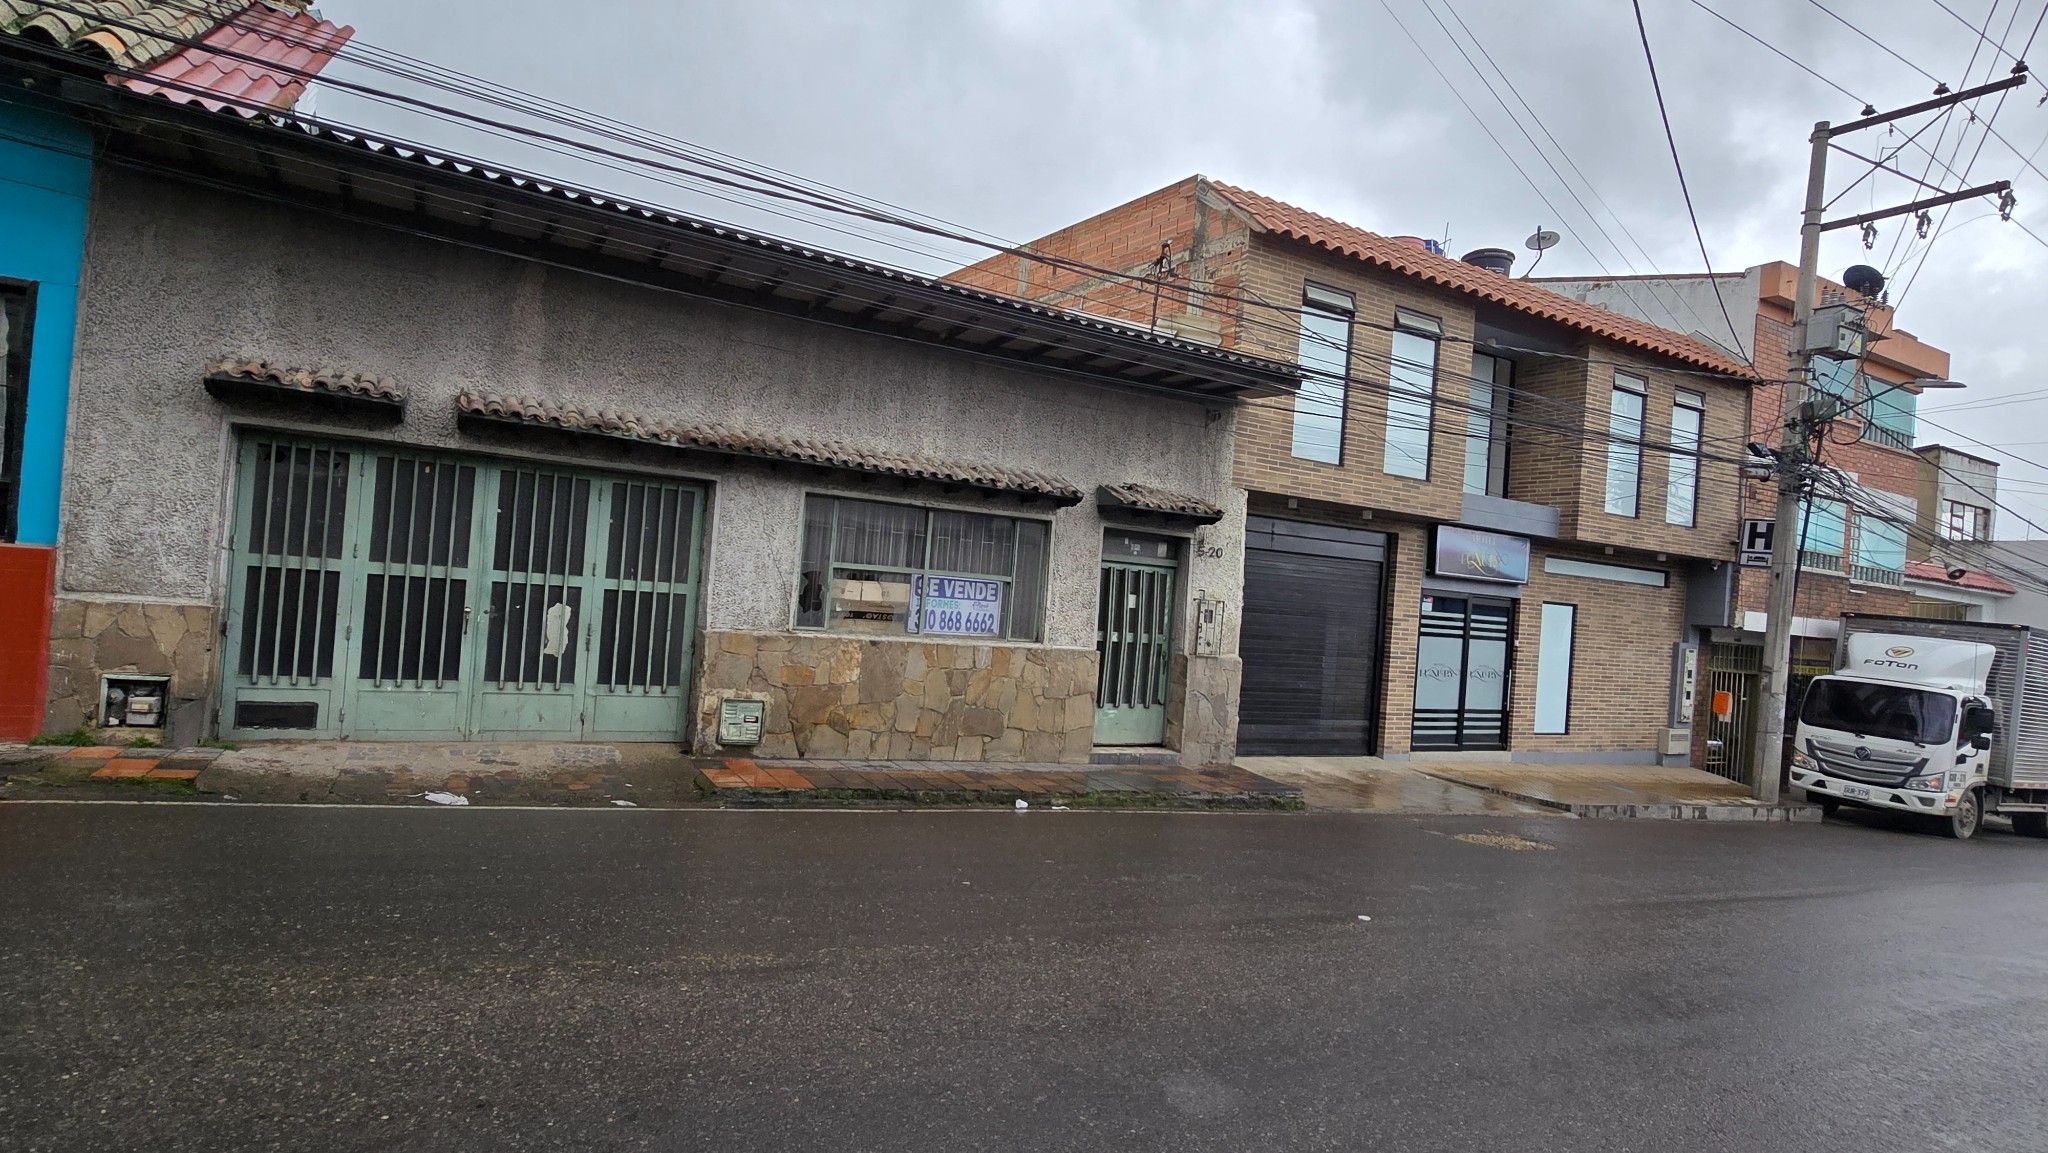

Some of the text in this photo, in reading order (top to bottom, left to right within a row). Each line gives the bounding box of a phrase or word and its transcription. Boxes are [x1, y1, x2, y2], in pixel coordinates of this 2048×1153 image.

[1747, 522, 1775, 550] H
[944, 580, 997, 601] VENDE
[939, 610, 962, 632] 868
[965, 612, 995, 633] 6662
